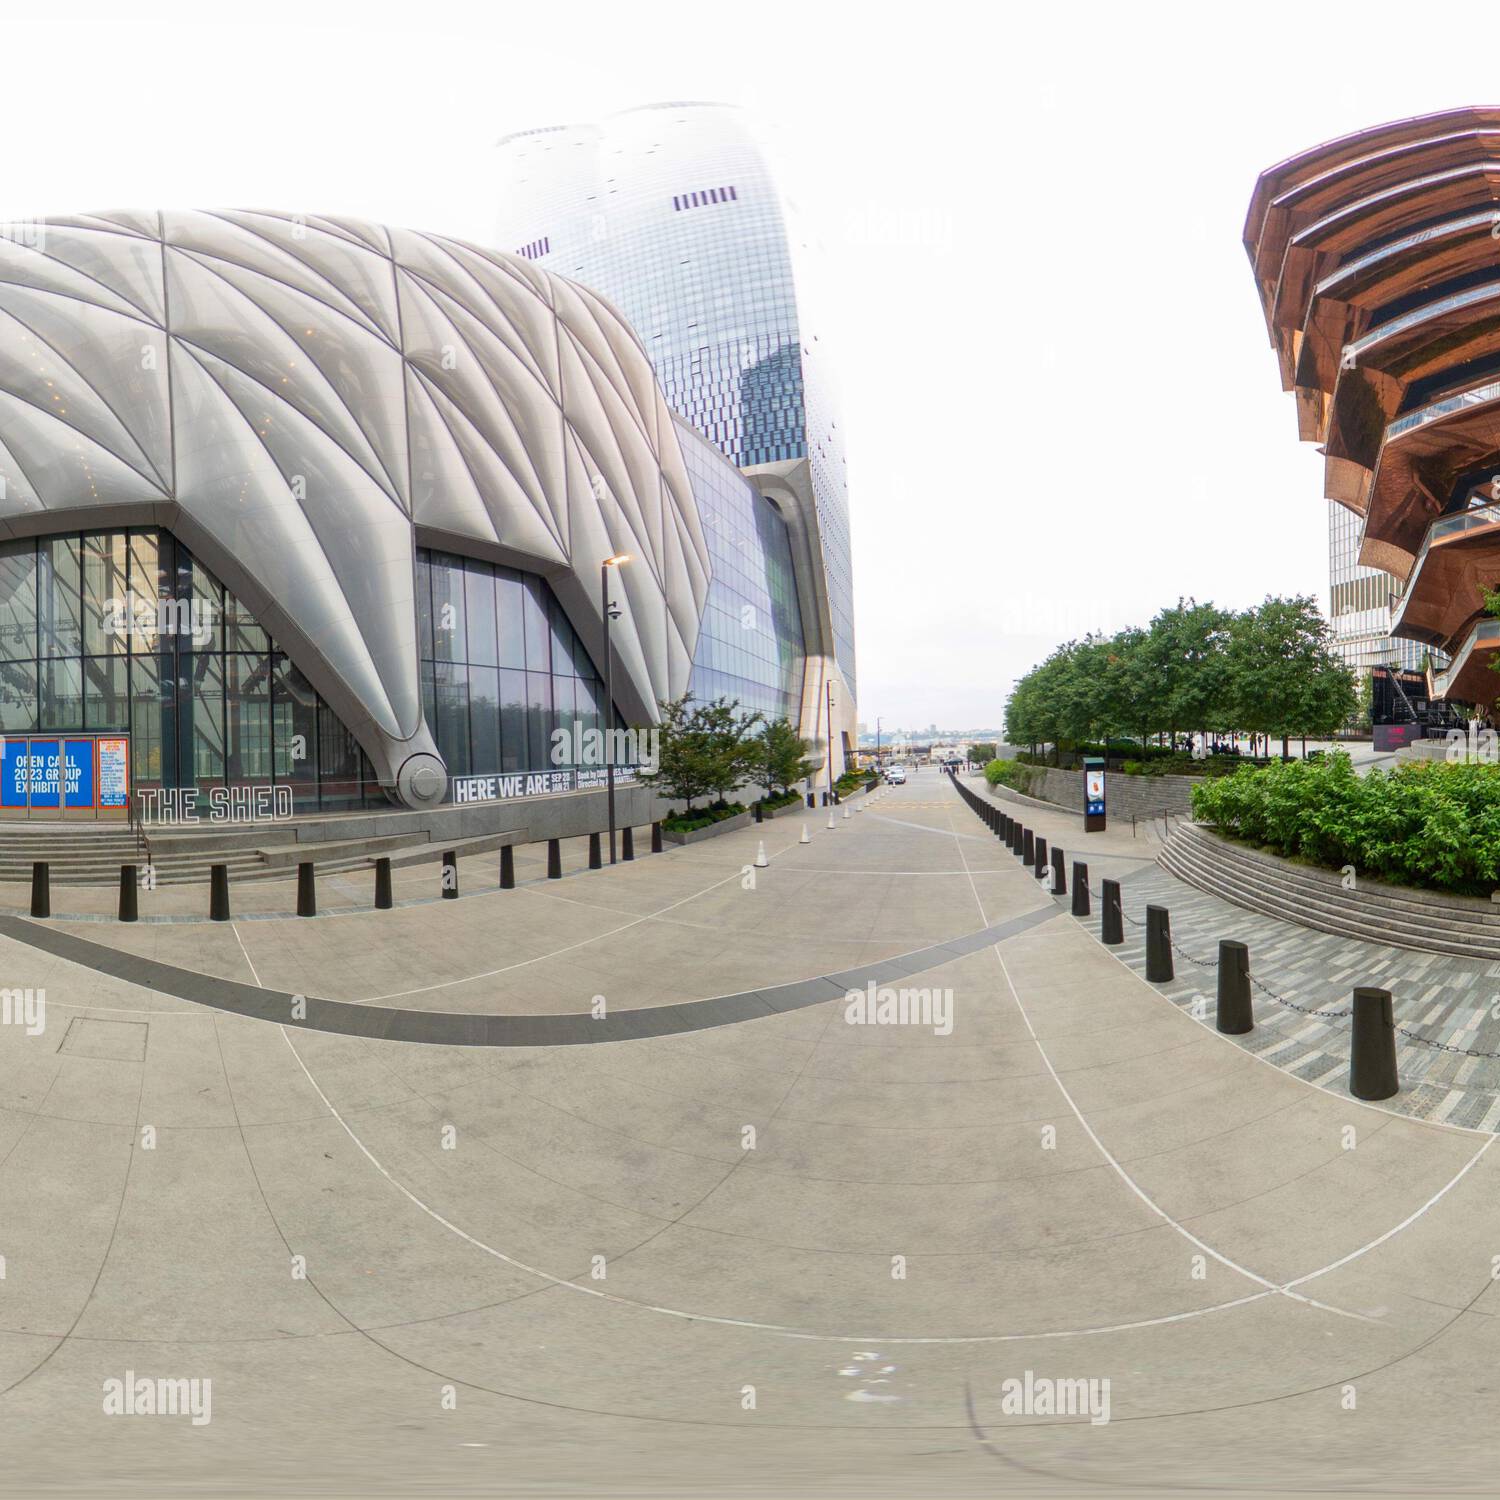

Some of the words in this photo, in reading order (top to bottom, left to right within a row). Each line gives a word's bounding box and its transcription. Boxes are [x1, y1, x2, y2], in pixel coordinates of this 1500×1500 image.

[14, 768, 43, 780] 2023
[15, 781, 79, 793] EXHIBITION
[457, 778, 497, 802] HERE
[498, 776, 524, 798] WE
[526, 774, 550, 796] ARE
[137, 788, 200, 825] THE
[209, 785, 293, 824] SHED
